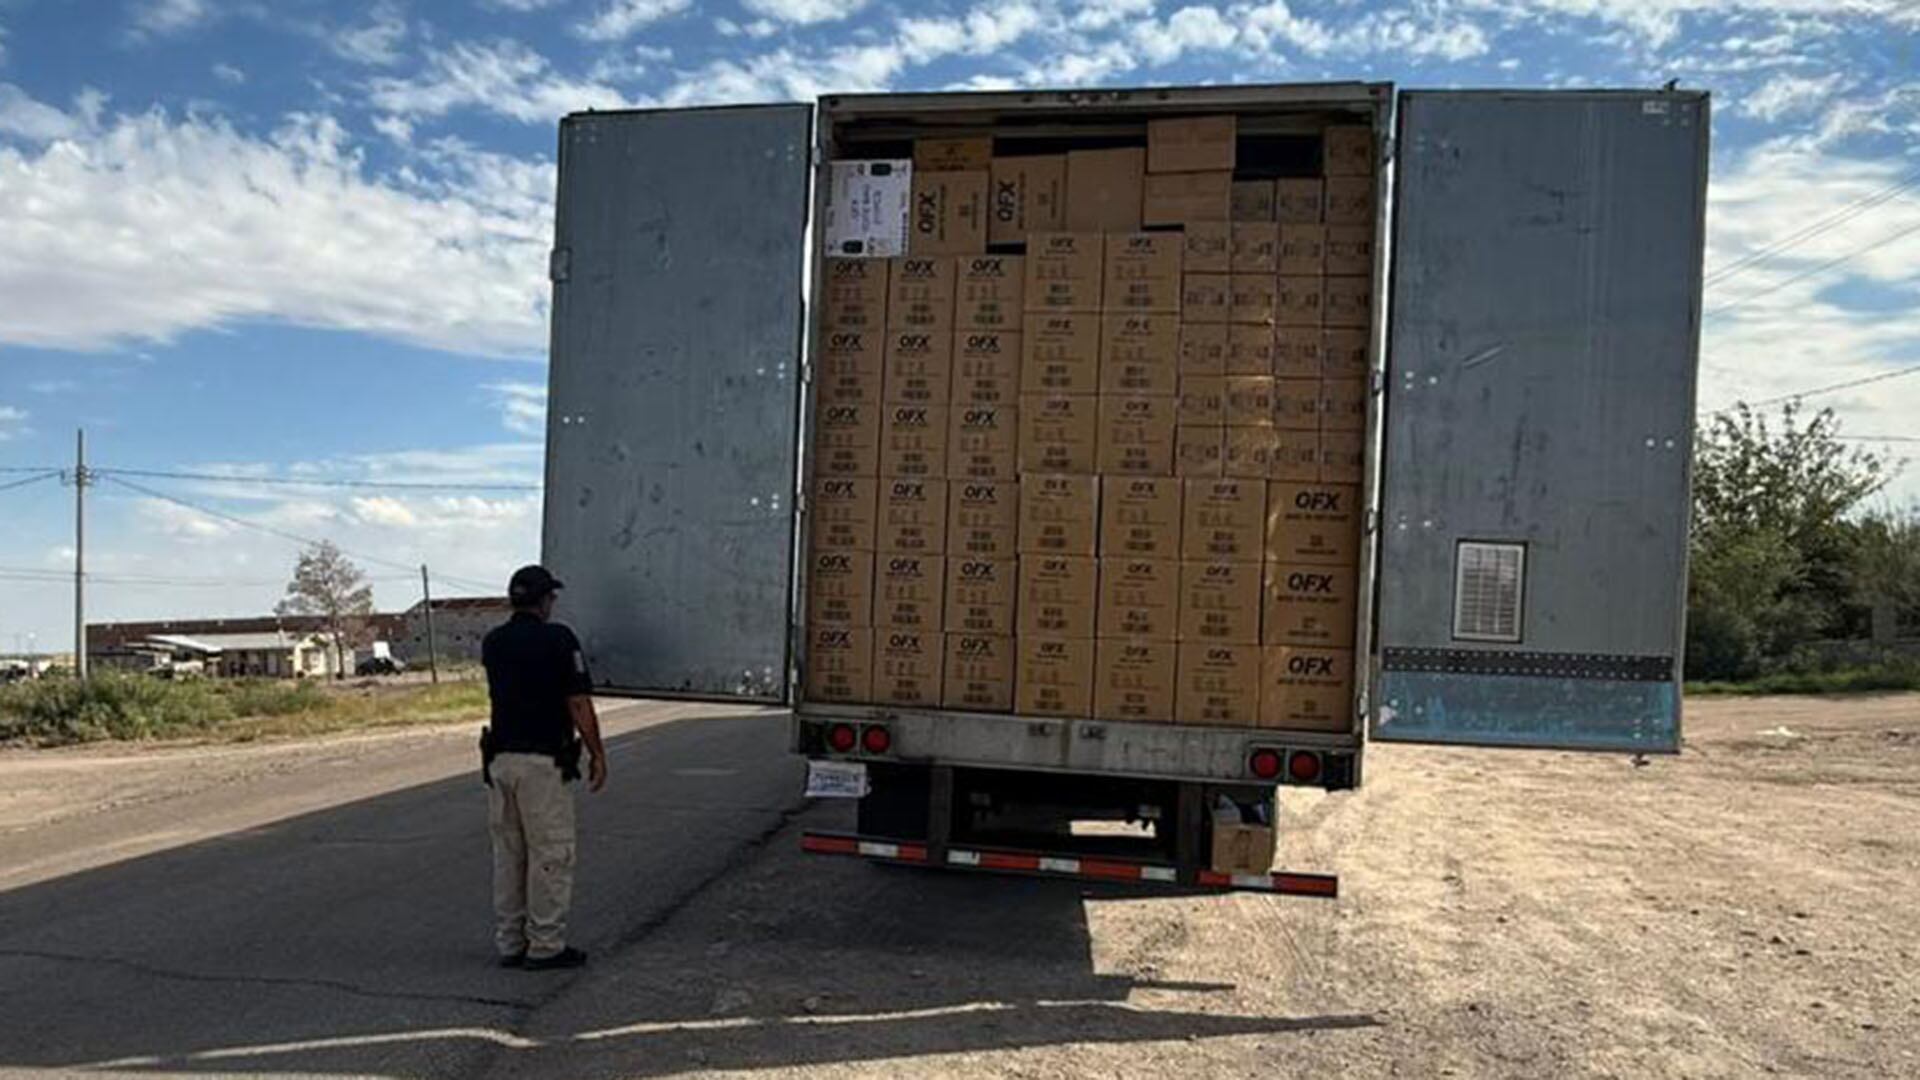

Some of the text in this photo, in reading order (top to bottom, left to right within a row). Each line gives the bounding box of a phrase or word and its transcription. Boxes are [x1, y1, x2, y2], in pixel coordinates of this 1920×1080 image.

[996, 181, 1015, 222] OFX
[918, 193, 936, 234] OFX
[1296, 493, 1340, 510] OFX
[1288, 574, 1332, 592] OFX
[1288, 658, 1333, 674] OFX
